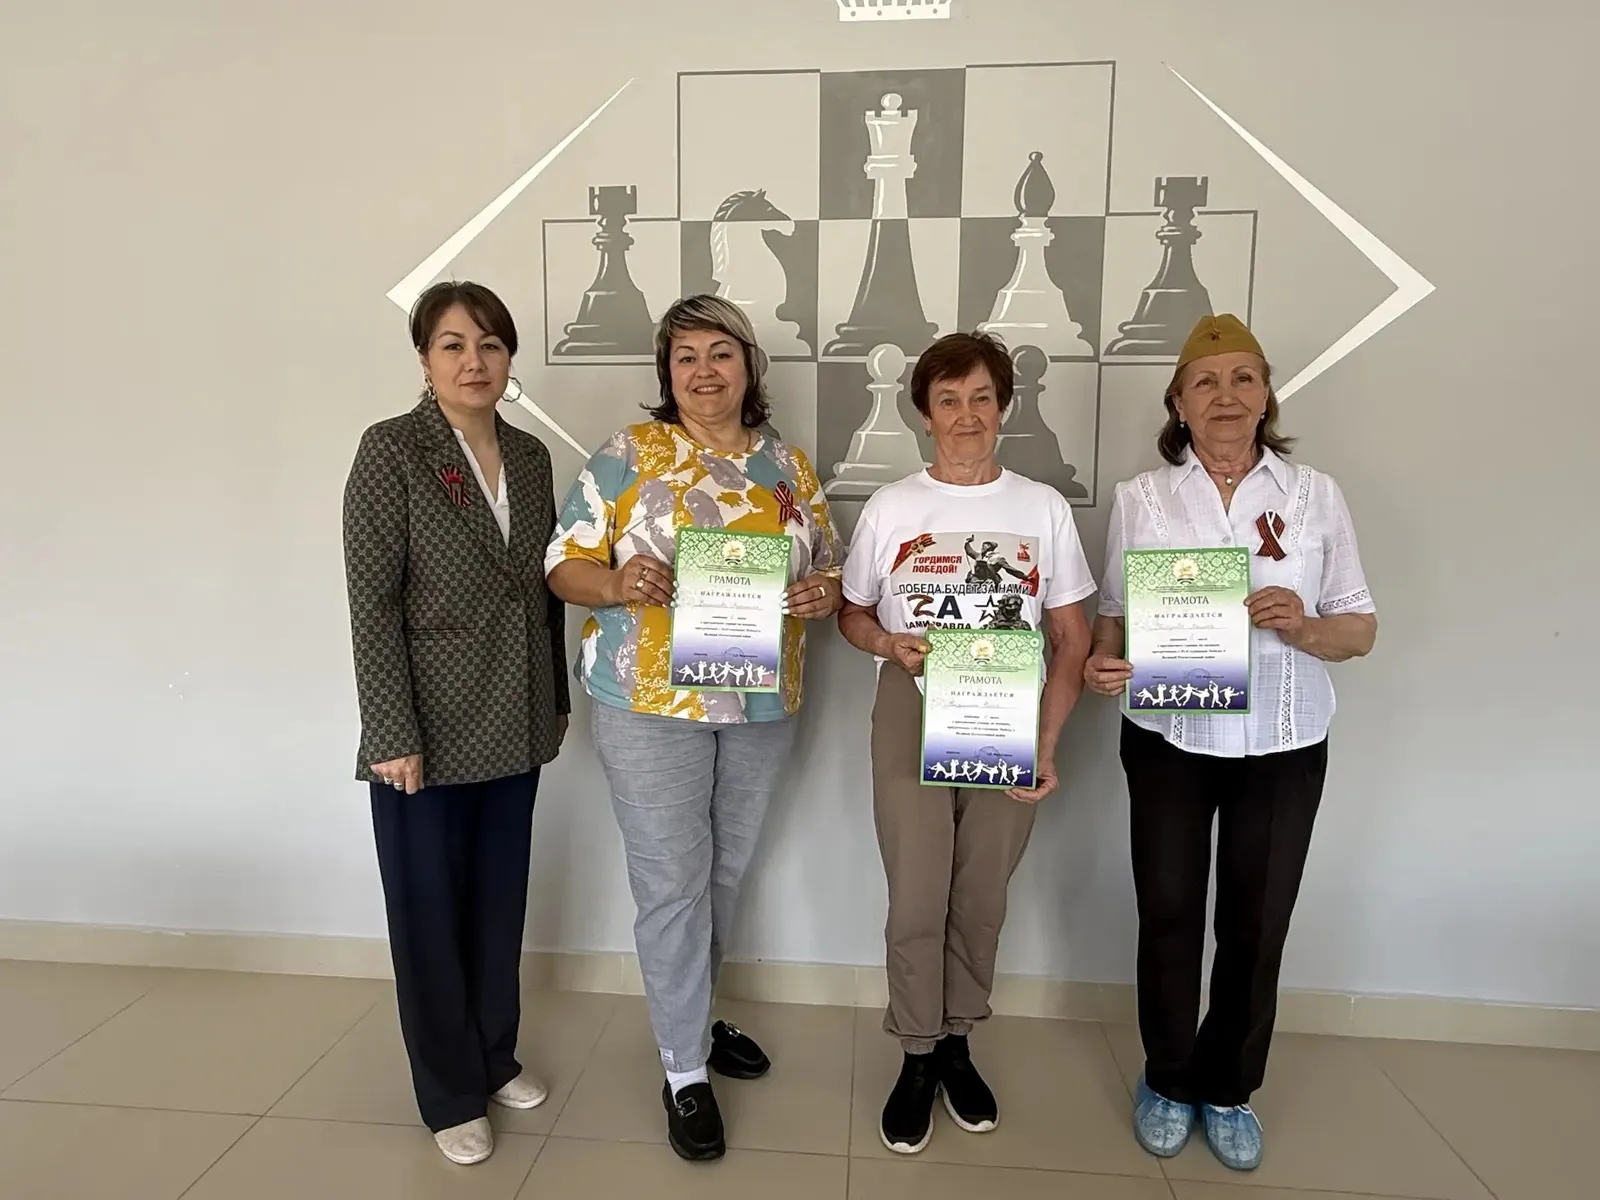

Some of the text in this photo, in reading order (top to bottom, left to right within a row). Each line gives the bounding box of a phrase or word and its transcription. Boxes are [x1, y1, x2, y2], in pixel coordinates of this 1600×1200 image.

[913, 555, 963, 565] ГОРДИМСЯ
[912, 564, 957, 574] ПОБЕДОЙ!
[708, 574, 752, 586] ГРАМОТА
[700, 590, 762, 599] НАГРАЖДАЕТСЯ
[1161, 596, 1210, 606] ГРАМОТА
[1154, 611, 1224, 619] НАГРАЖДАЕТСЯ
[933, 621, 972, 630] РАВДА
[959, 674, 1003, 685] ГРАМОТА
[950, 690, 1015, 698] НАГРАЖДАЕТСЯ
